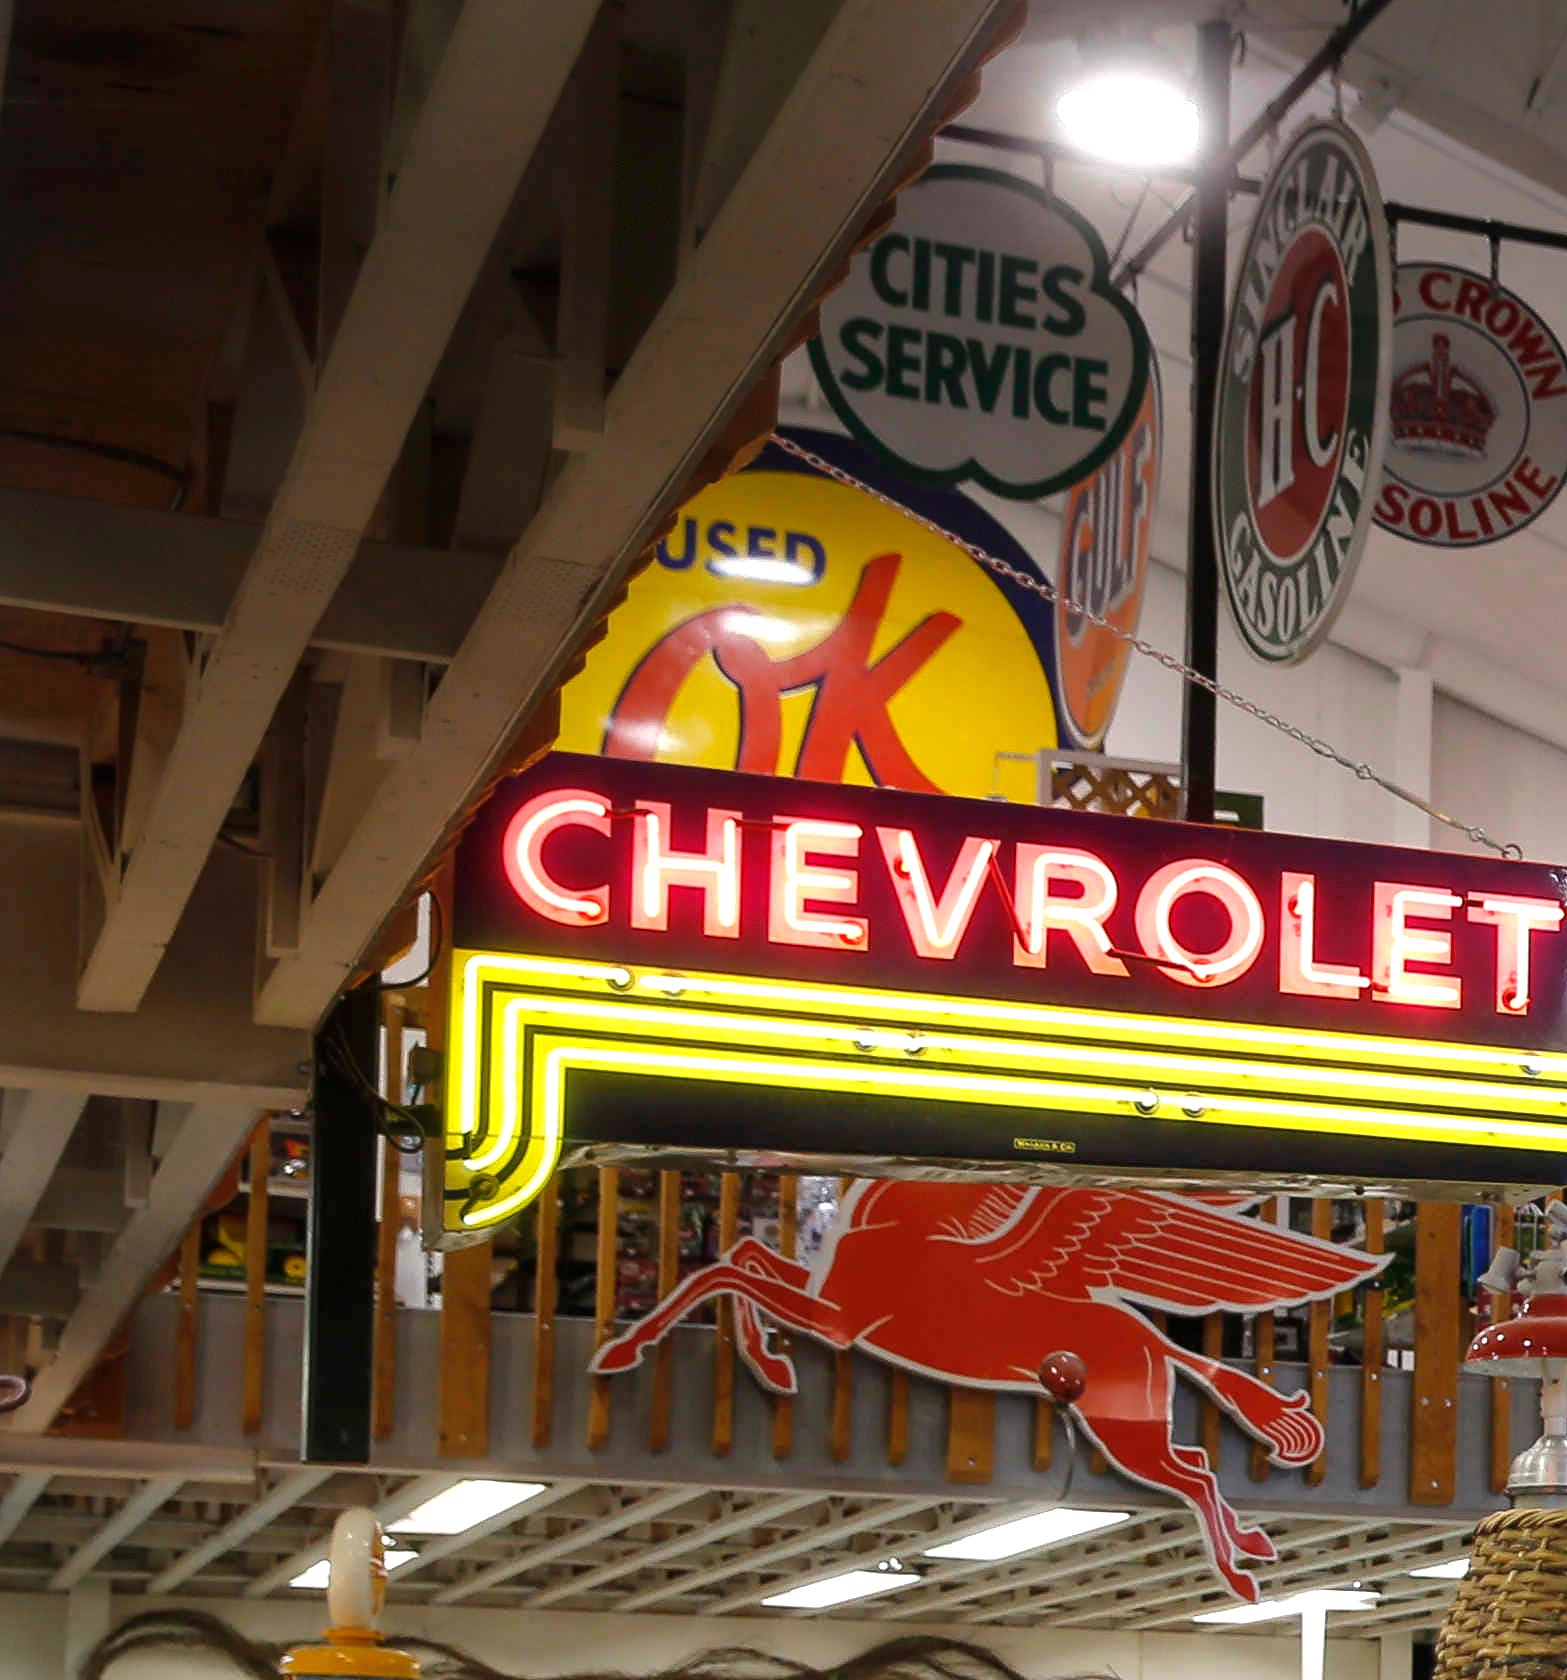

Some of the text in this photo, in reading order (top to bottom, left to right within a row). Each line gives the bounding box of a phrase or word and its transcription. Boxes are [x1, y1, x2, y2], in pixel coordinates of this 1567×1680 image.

[836, 315, 1109, 432] SERVICE
[870, 233, 1086, 336] CITIES
[1233, 152, 1368, 384] SINCLAIR
[656, 517, 828, 586] USED
[1065, 422, 1151, 646] GULF
[1230, 428, 1370, 644] GASOLINE
[1372, 456, 1558, 542] SOLINE
[602, 553, 963, 796] OK
[503, 788, 1566, 1015] CHEVROLET
